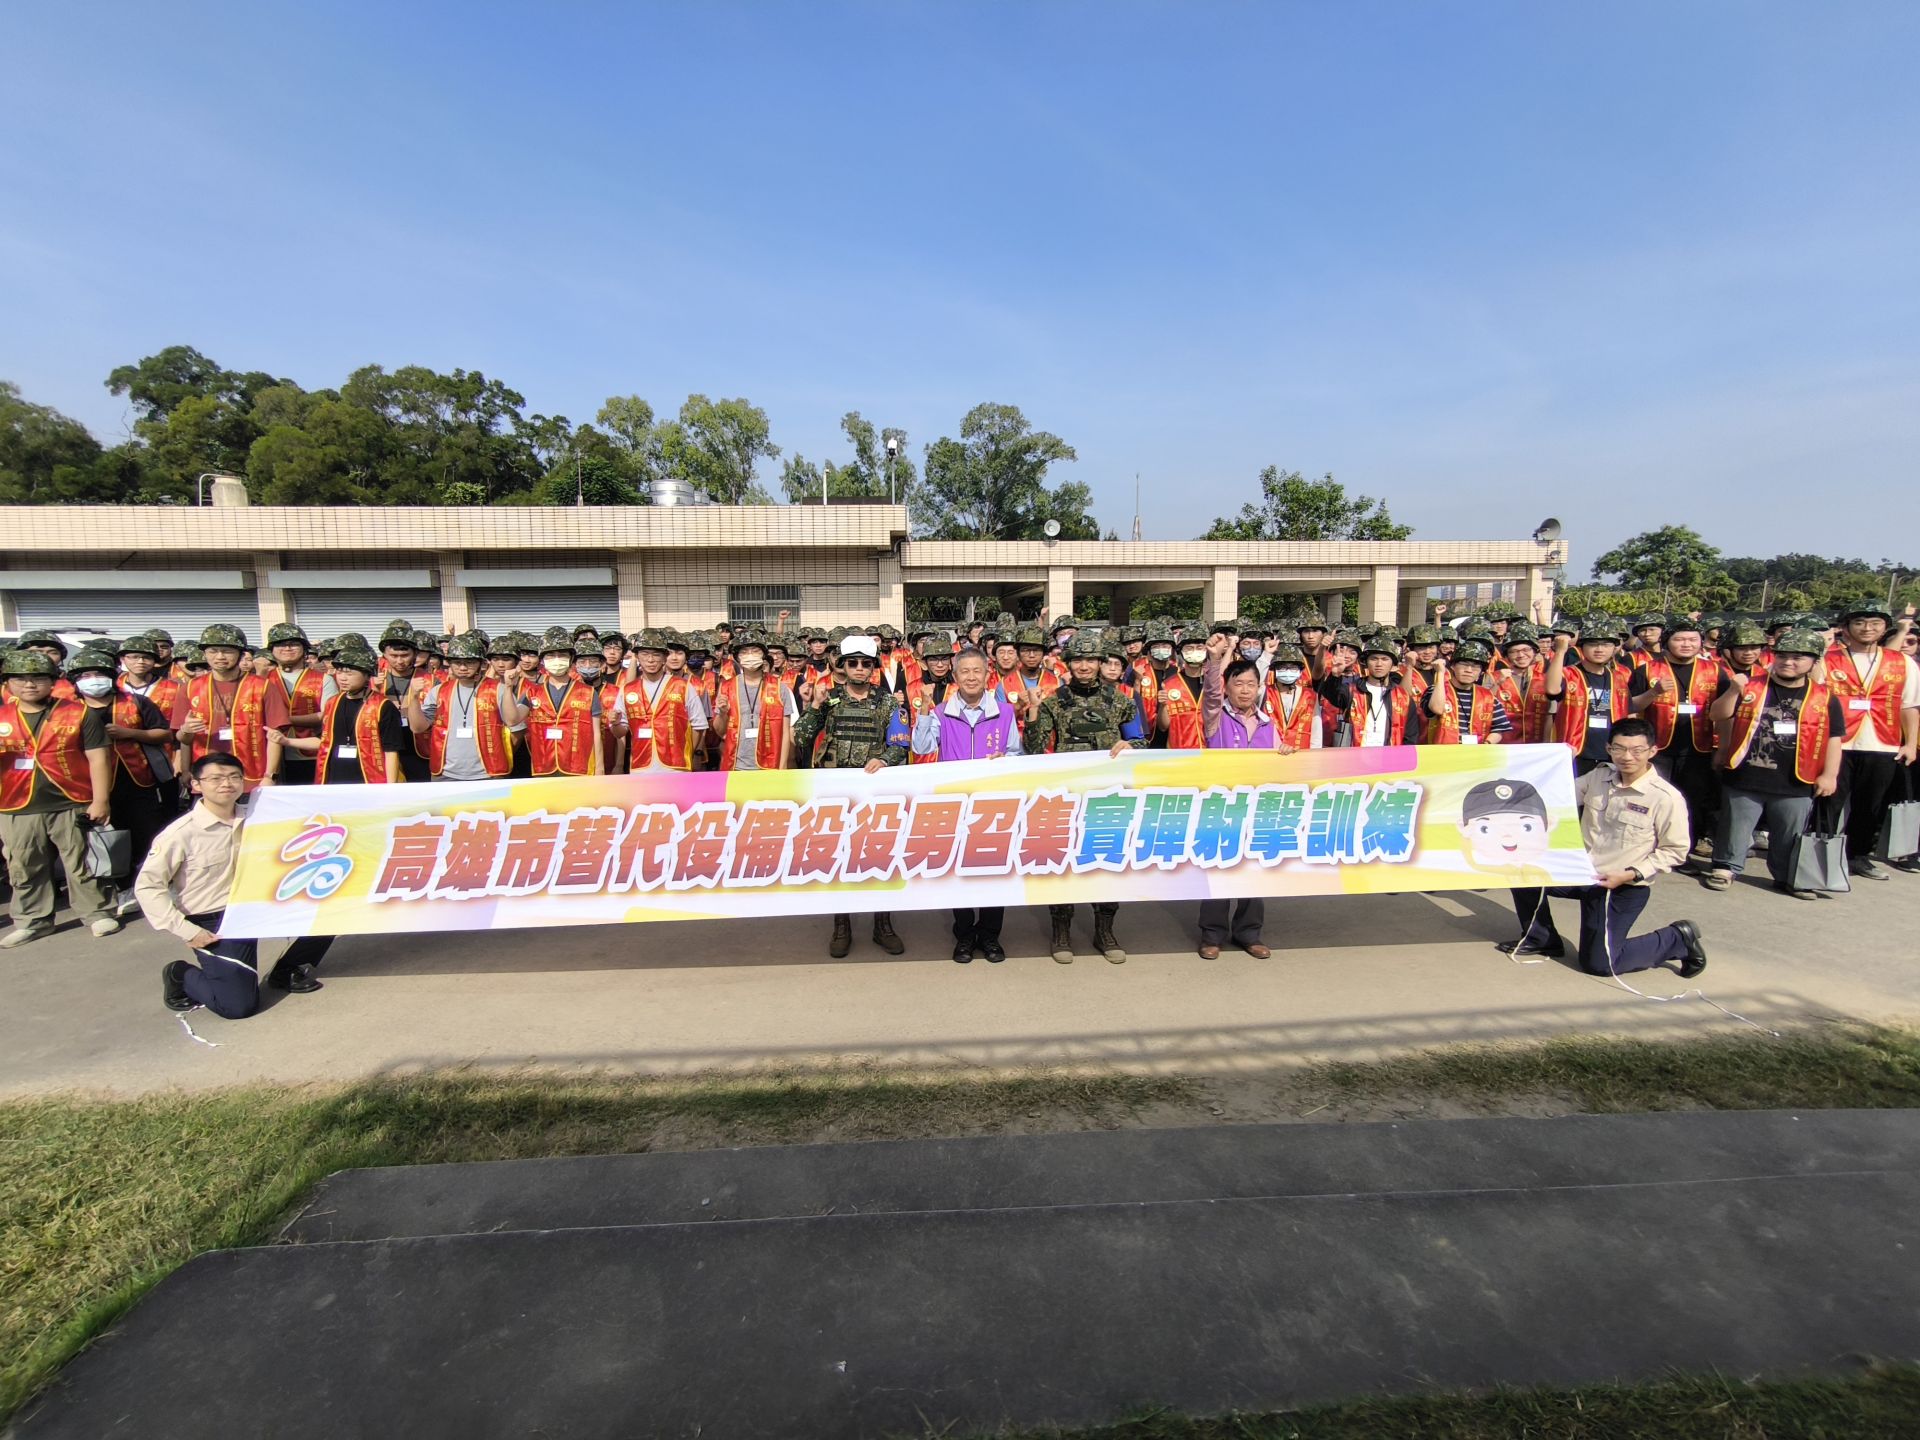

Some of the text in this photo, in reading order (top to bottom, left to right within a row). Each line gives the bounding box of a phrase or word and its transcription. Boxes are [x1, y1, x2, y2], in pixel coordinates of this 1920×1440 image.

[375, 784, 1420, 895] 高雄市替代役備役役男召集實彈射擊訓練
